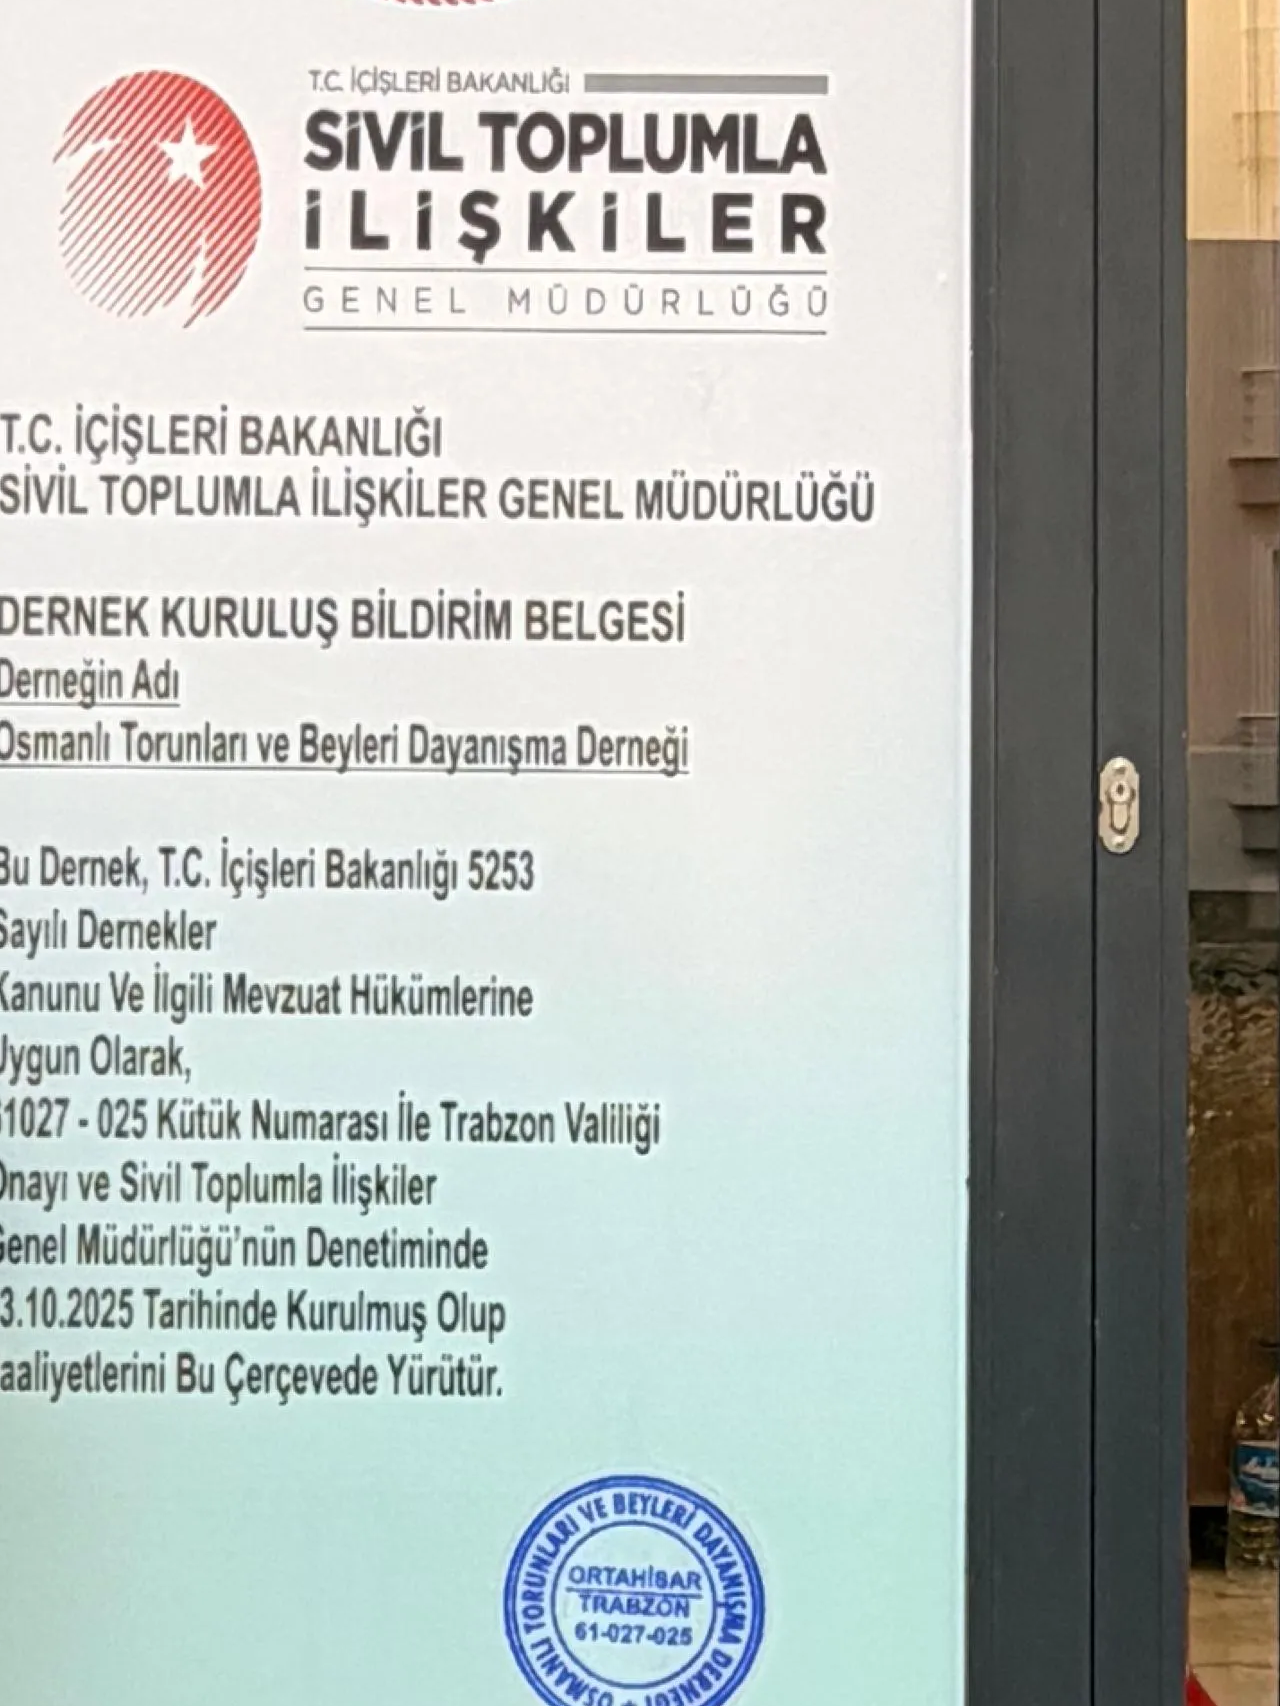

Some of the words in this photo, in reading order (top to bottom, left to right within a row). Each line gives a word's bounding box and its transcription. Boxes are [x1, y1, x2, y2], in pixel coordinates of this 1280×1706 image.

[309, 70, 343, 91] T.C.
[351, 67, 440, 95] İÇİŞLERİ
[447, 67, 569, 94] BAKANLIĞI
[304, 109, 464, 172] SİVİL
[478, 111, 827, 175] TOPLUMLA
[306, 189, 826, 265] İLİŞKİLER
[304, 286, 465, 313] GENEL
[508, 284, 827, 317] MÜDÜRLÜĞÜ
[0, 413, 62, 454] T.C.
[76, 403, 227, 465] İÇİŞLERİ
[240, 406, 442, 458] BAKANLIĞI
[99, 474, 301, 517] TOPLUMLA
[312, 466, 487, 528] İLİŞKİLER
[499, 477, 624, 519] GENEL
[636, 469, 874, 522] MÜDÜRLÜĞÜ
[162, 596, 338, 649] KURULUŞ
[352, 588, 512, 640] BİLDİRİM
[525, 590, 684, 642] BELGESİ
[132, 662, 179, 700] Adı
[121, 723, 248, 765] Torunları
[257, 732, 290, 765] ve
[300, 724, 399, 773] Beyleri
[410, 726, 569, 776] Dayanışma
[577, 726, 688, 775] Derneği
[40, 845, 148, 894] Dernek,
[158, 846, 210, 888] T.C.
[221, 836, 315, 899] İçişleri
[325, 848, 457, 901] Bakanlığı
[468, 849, 534, 891] 5253
[78, 908, 217, 951] Dernekler
[109, 971, 144, 1013] Ve
[154, 962, 213, 1025] İlgili
[223, 972, 342, 1014] Mevzuat
[351, 974, 533, 1017] Hükümlerine
[90, 1034, 191, 1084] Olarak,
[97, 1097, 148, 1139] 025
[157, 1098, 241, 1140] Kütük
[252, 1099, 388, 1142] Numarası
[399, 1090, 431, 1142] İle
[440, 1100, 555, 1143] Trabzon
[564, 1102, 660, 1156] Valiliği
[78, 1171, 110, 1201] ve
[120, 1160, 181, 1203] Sivil
[191, 1161, 322, 1214] Toplumla
[333, 1152, 437, 1216] İlişkiler
[307, 1226, 488, 1269] Denetiminde
[143, 1288, 277, 1331] Tarihinde
[287, 1289, 427, 1343] Kurulmuş
[438, 1290, 506, 1344] Olup
[177, 1352, 214, 1394] Bu
[225, 1351, 378, 1406] Çerçevede
[387, 1354, 502, 1397] Yürütür.
[521, 1512, 580, 1633] TORUNLARI
[578, 1493, 608, 1523] VE
[613, 1492, 698, 1528] BEYLERİ
[574, 1623, 692, 1645] 61-027-025
